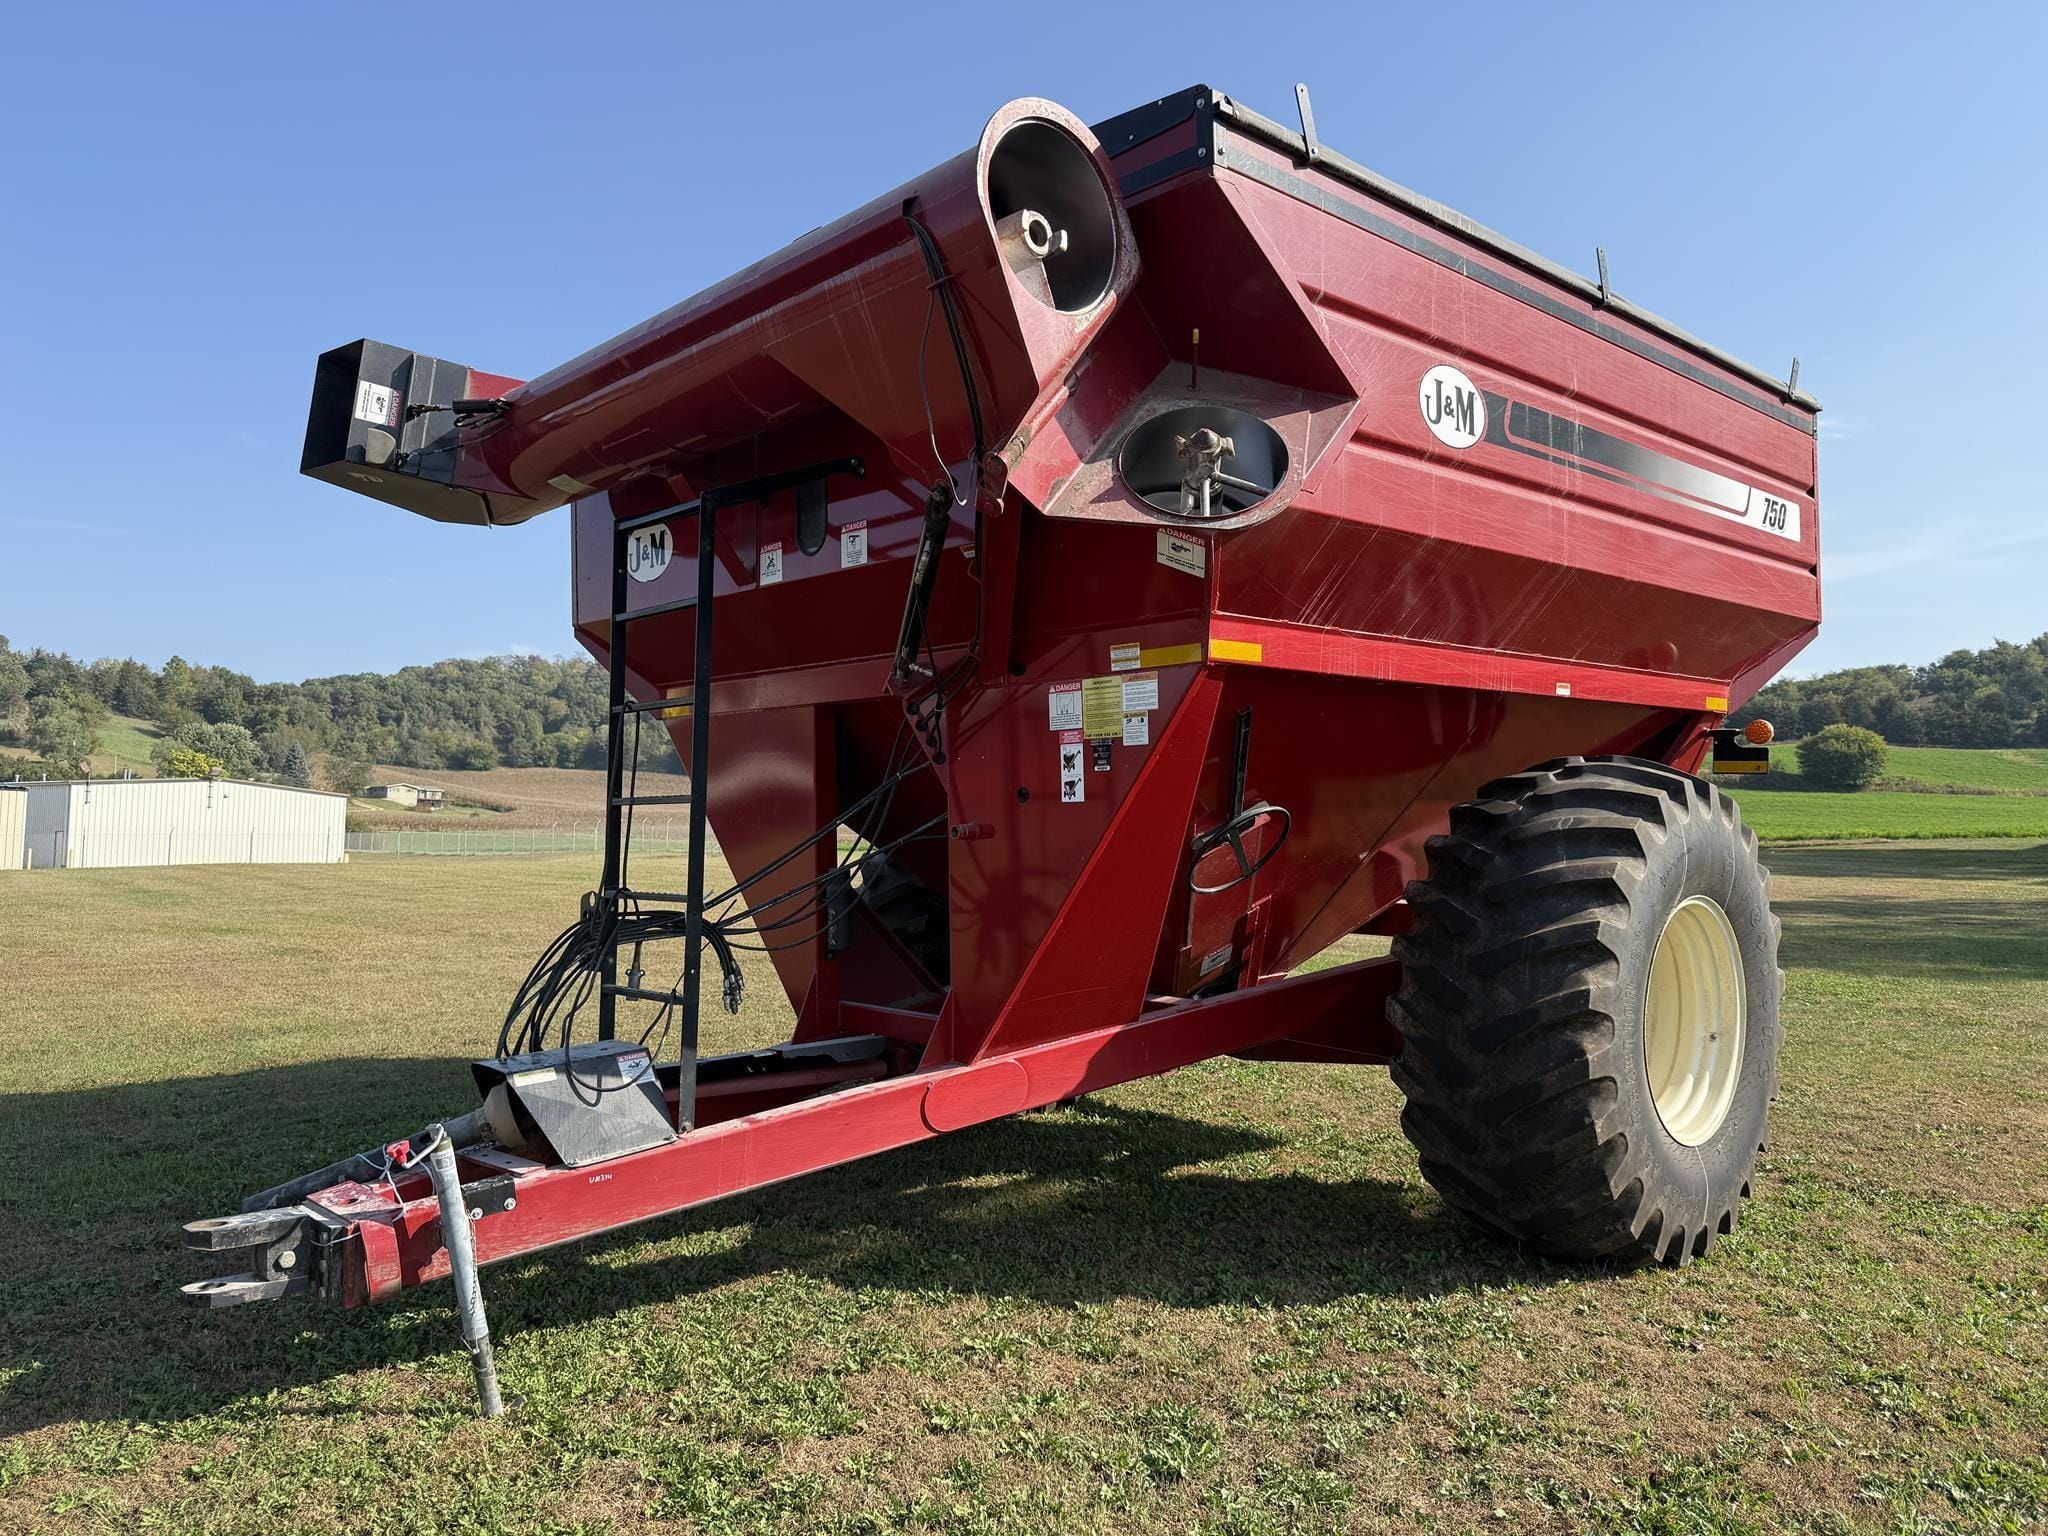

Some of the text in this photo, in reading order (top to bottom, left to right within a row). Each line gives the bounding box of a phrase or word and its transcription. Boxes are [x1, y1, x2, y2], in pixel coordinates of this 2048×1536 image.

[388, 396, 400, 426] DANGER
[1425, 379, 1476, 437] J&M
[1762, 497, 1787, 531] 750
[846, 520, 867, 532] DANGER
[1166, 528, 1205, 546] DANGER
[628, 530, 666, 573] J&M
[763, 542, 782, 551] DANGER
[1055, 683, 1081, 692] DANGER
[624, 1052, 647, 1061] DANGER
